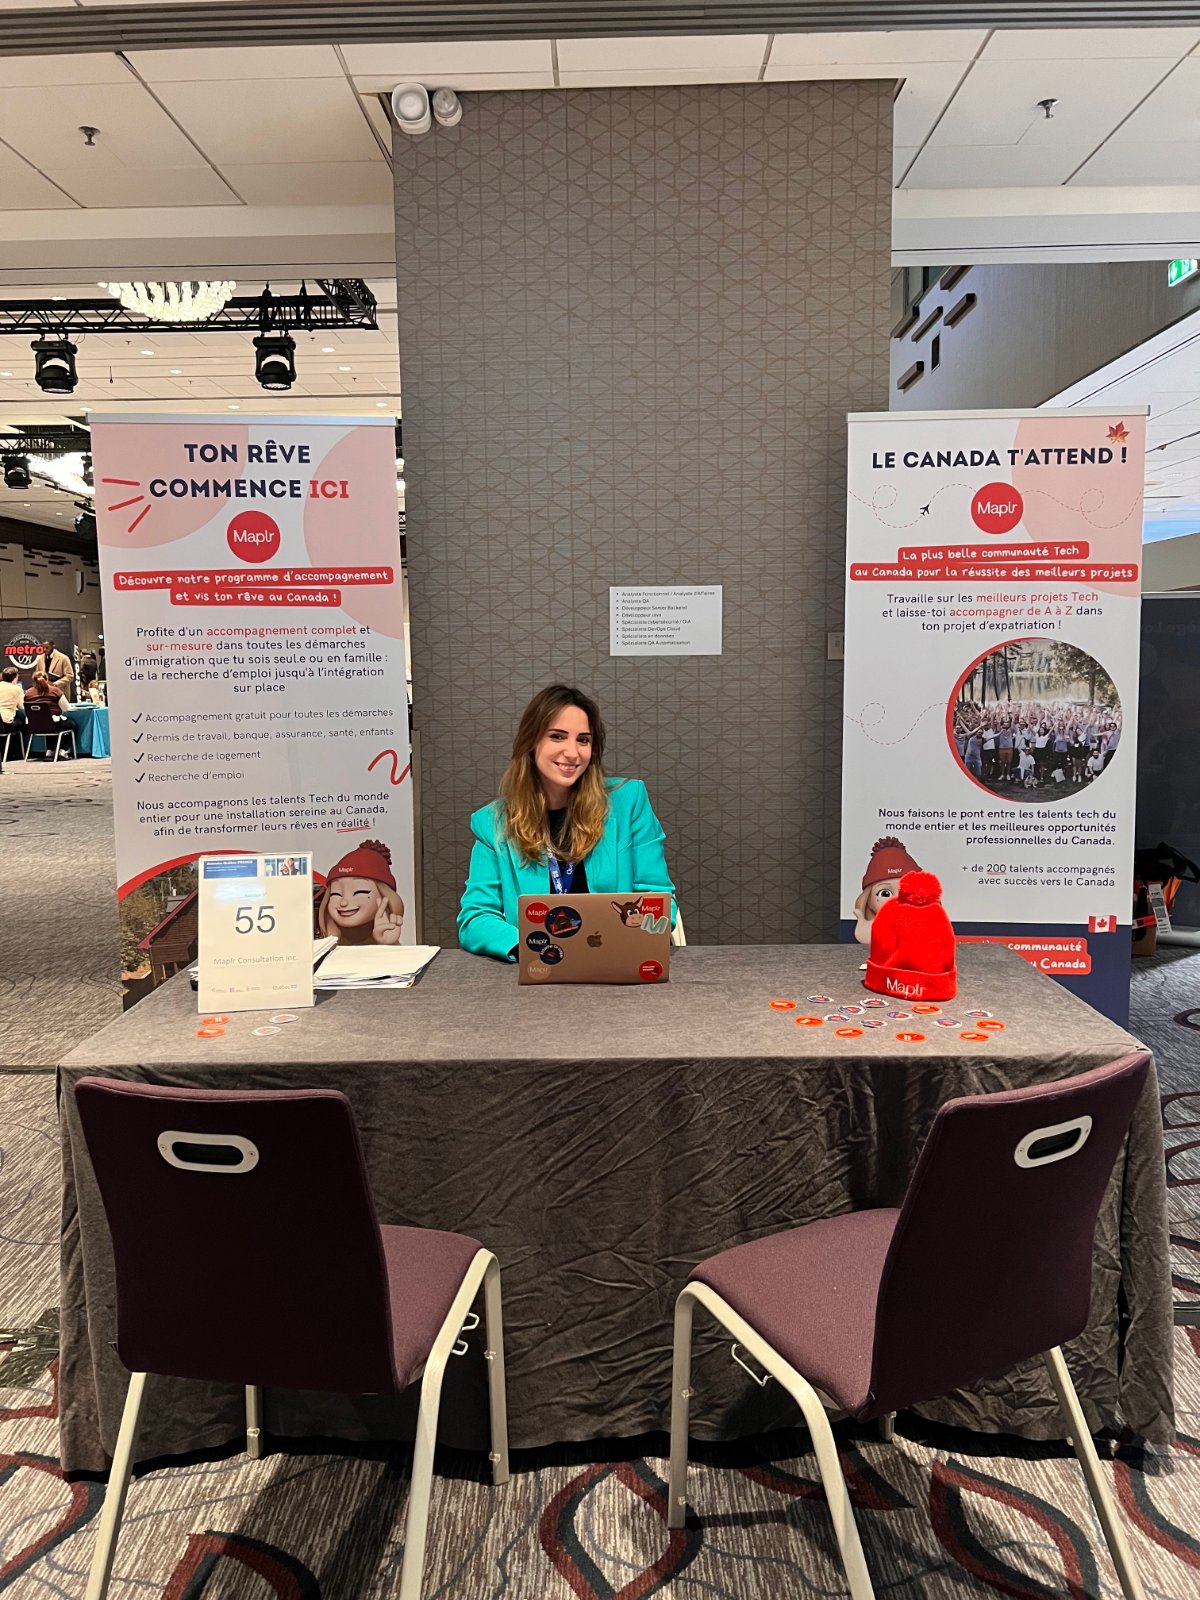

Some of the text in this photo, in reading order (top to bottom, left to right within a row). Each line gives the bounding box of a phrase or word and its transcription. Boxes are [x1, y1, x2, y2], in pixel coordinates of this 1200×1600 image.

[183, 440, 311, 463] TON RÊVE
[873, 448, 1113, 469] LE CANADA T'ATTEND
[149, 479, 349, 498] COMMENCE ICI
[977, 501, 1017, 517] Maplr
[233, 529, 274, 546] Maplr
[903, 546, 1079, 563] La plus belle communauté Tech
[119, 570, 388, 586] Découvre notre programme d'accompagnement
[872, 566, 1132, 579] Canada pour réussite des meilleurs projets
[194, 591, 329, 603] vis ton rêve Canada
[887, 592, 1098, 604] Travaille sur meilleurs projets Tech
[897, 605, 1102, 618] laisse-toi accompagner à Z dans
[137, 625, 356, 638] Profite d'un accompagnement complet
[922, 620, 1054, 633] ton projet d'expatriation
[5, 645, 44, 655] metro
[146, 638, 365, 651] sur-mesure dans toutes démarches
[125, 652, 381, 668] d'immigration que sois seul.e famille
[161, 666, 384, 681] recherche d'emploi jusqu'à l'intégration
[233, 682, 285, 696] sur place
[145, 708, 394, 723] Accompagnement gratuit pour toutes démarches
[146, 727, 394, 743] Permis travail, banque, assurance, santé, enfants
[147, 750, 261, 762] Recherche logement
[148, 770, 245, 782] Recherche d'emploi
[137, 792, 389, 812] Nous accompagnons talents Tech monde
[140, 805, 387, 825] entier pour une installation sereine Canada,
[878, 808, 1116, 821] Nous faisons pont entre talents tech du
[153, 818, 369, 836] afin transformer leurs rêves réalité
[886, 821, 1116, 834] monde entier meilleures opportunités
[966, 835, 1115, 847] professionnelles du Canada.
[987, 864, 1115, 876] 200 talents accompagnés
[979, 876, 1115, 887] avec succès vers Canada
[528, 909, 547, 917] Maplr
[642, 905, 661, 913] Maplr
[235, 905, 276, 934] 55
[529, 938, 548, 946] Maplr
[1008, 941, 1082, 951] communauté
[214, 958, 236, 966] Maplr
[238, 955, 283, 964] Consultation
[1040, 958, 1086, 969] Canada
[886, 977, 924, 998] Maplr
